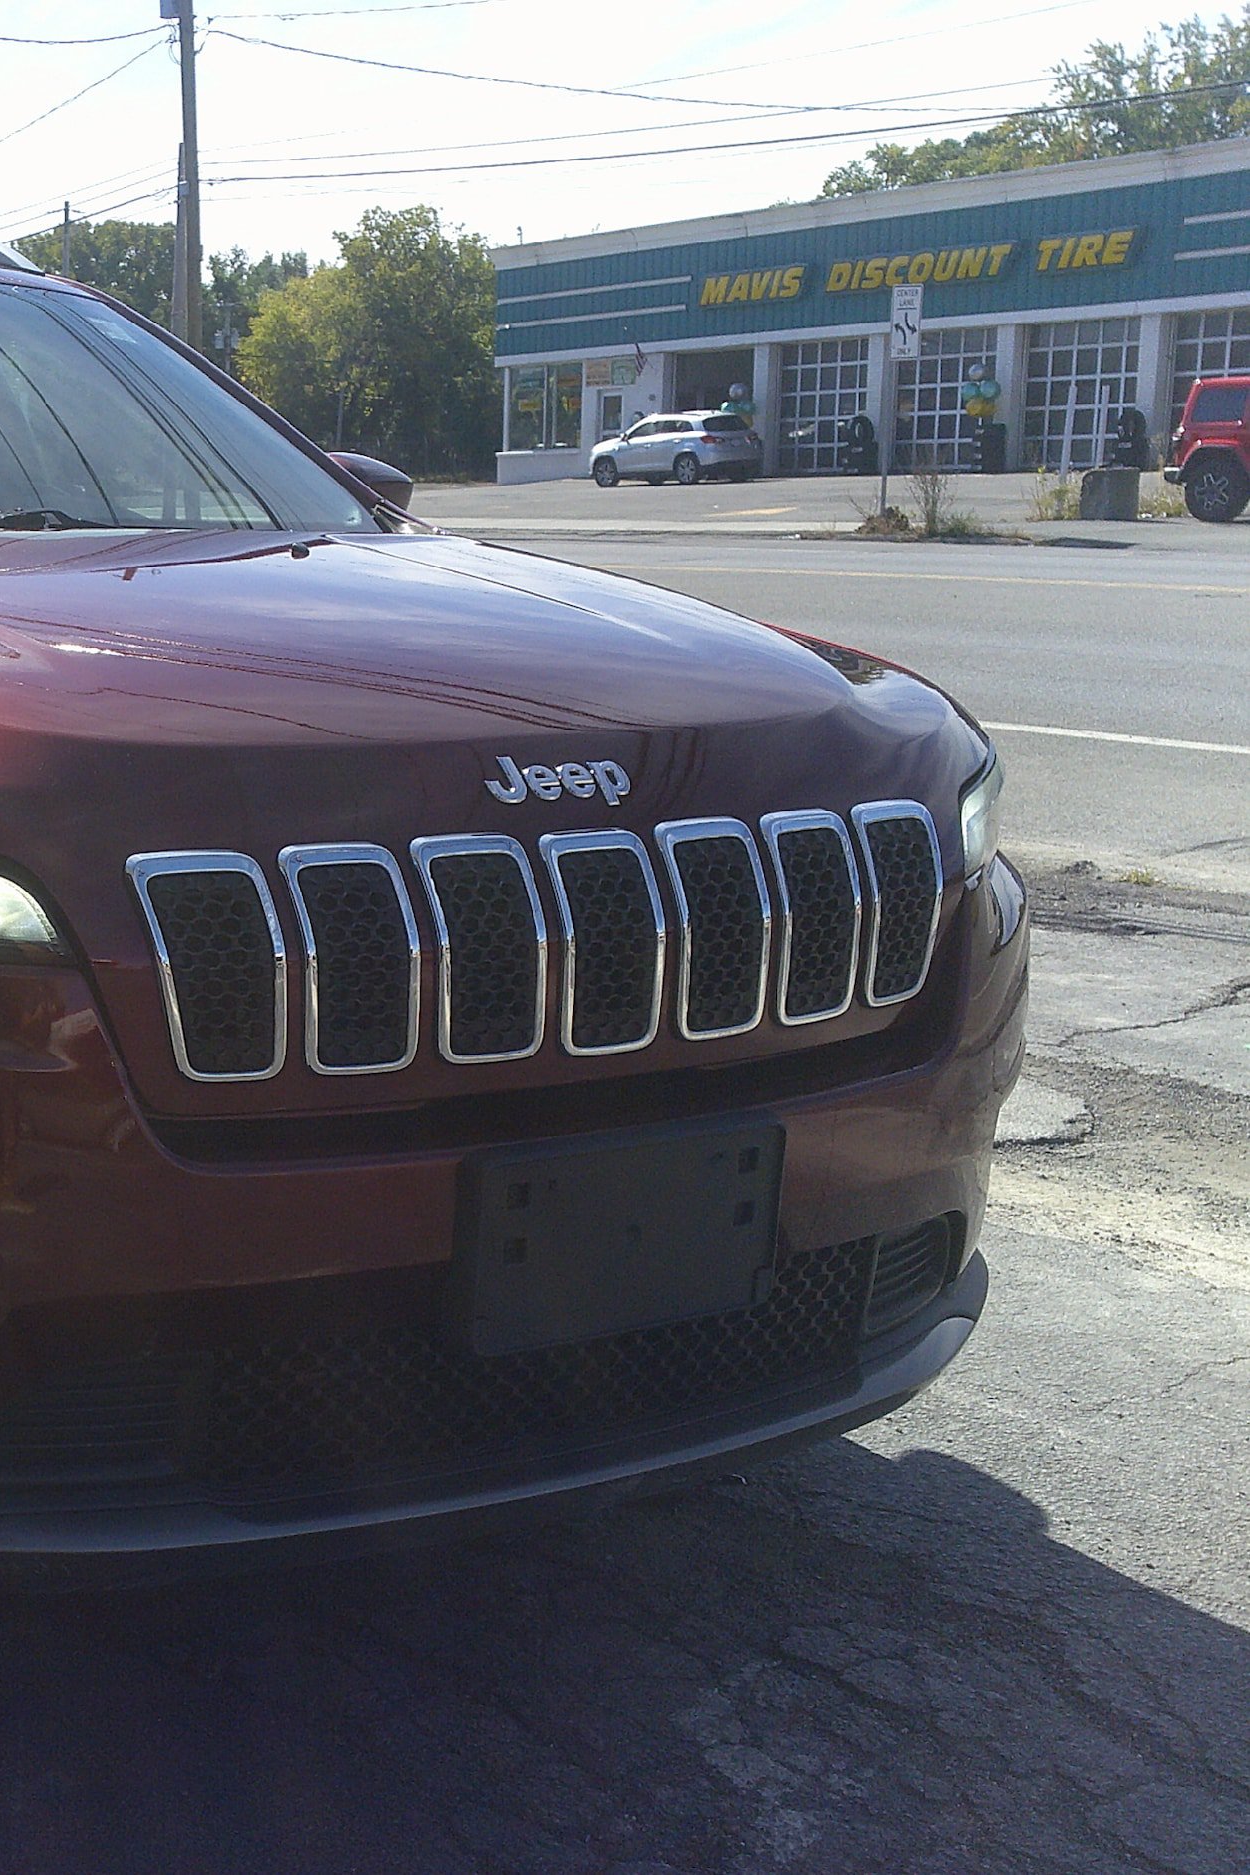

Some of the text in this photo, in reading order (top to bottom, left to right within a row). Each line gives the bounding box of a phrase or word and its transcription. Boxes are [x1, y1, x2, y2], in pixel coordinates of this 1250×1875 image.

[701, 230, 1134, 306] MAVIS DISCOUNT TIRE
[896, 288, 919, 297] CENTER
[899, 298, 915, 307] LANE
[484, 755, 631, 807] Jeep
